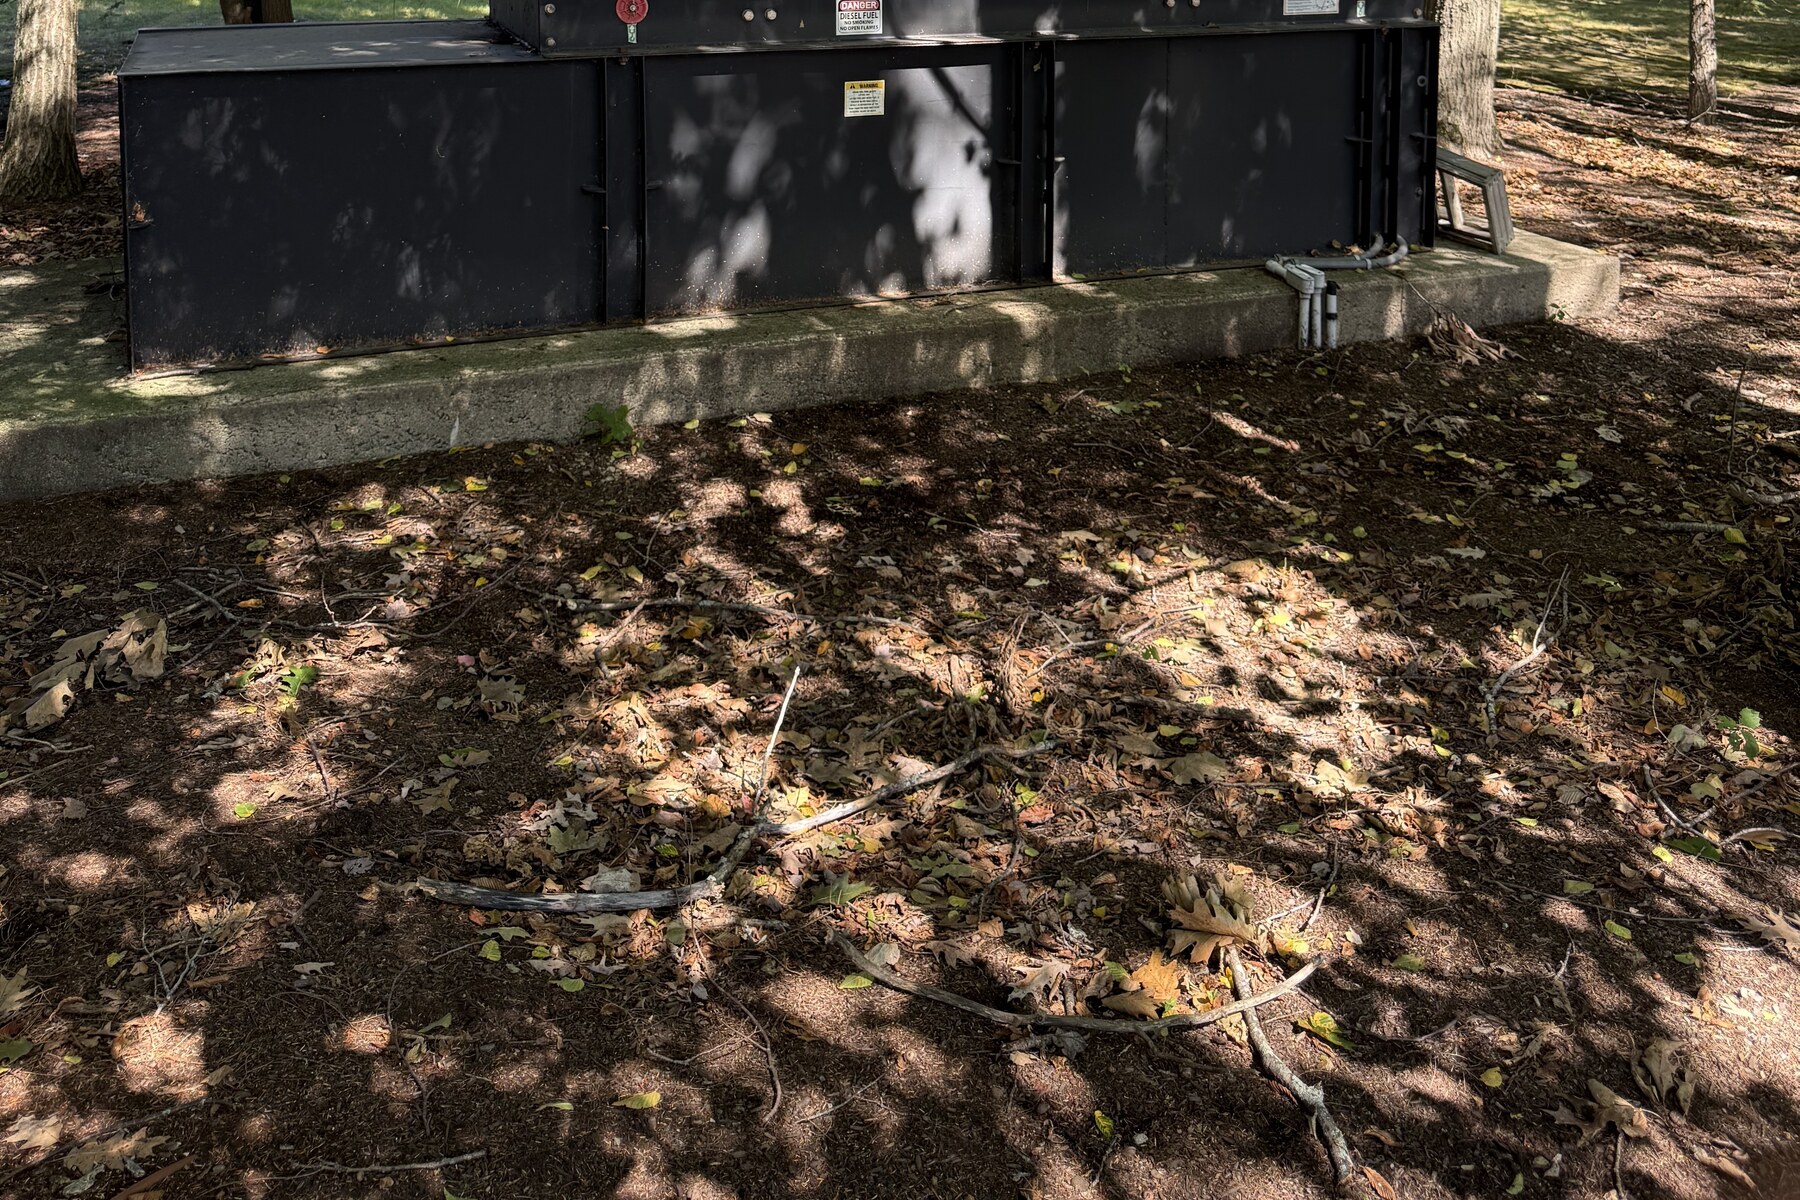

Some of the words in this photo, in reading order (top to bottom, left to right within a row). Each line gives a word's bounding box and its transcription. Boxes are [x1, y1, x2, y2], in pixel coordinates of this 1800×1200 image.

[841, 1, 877, 10] DANGER
[840, 12, 861, 20] DIESEL
[863, 11, 878, 19] FUEL
